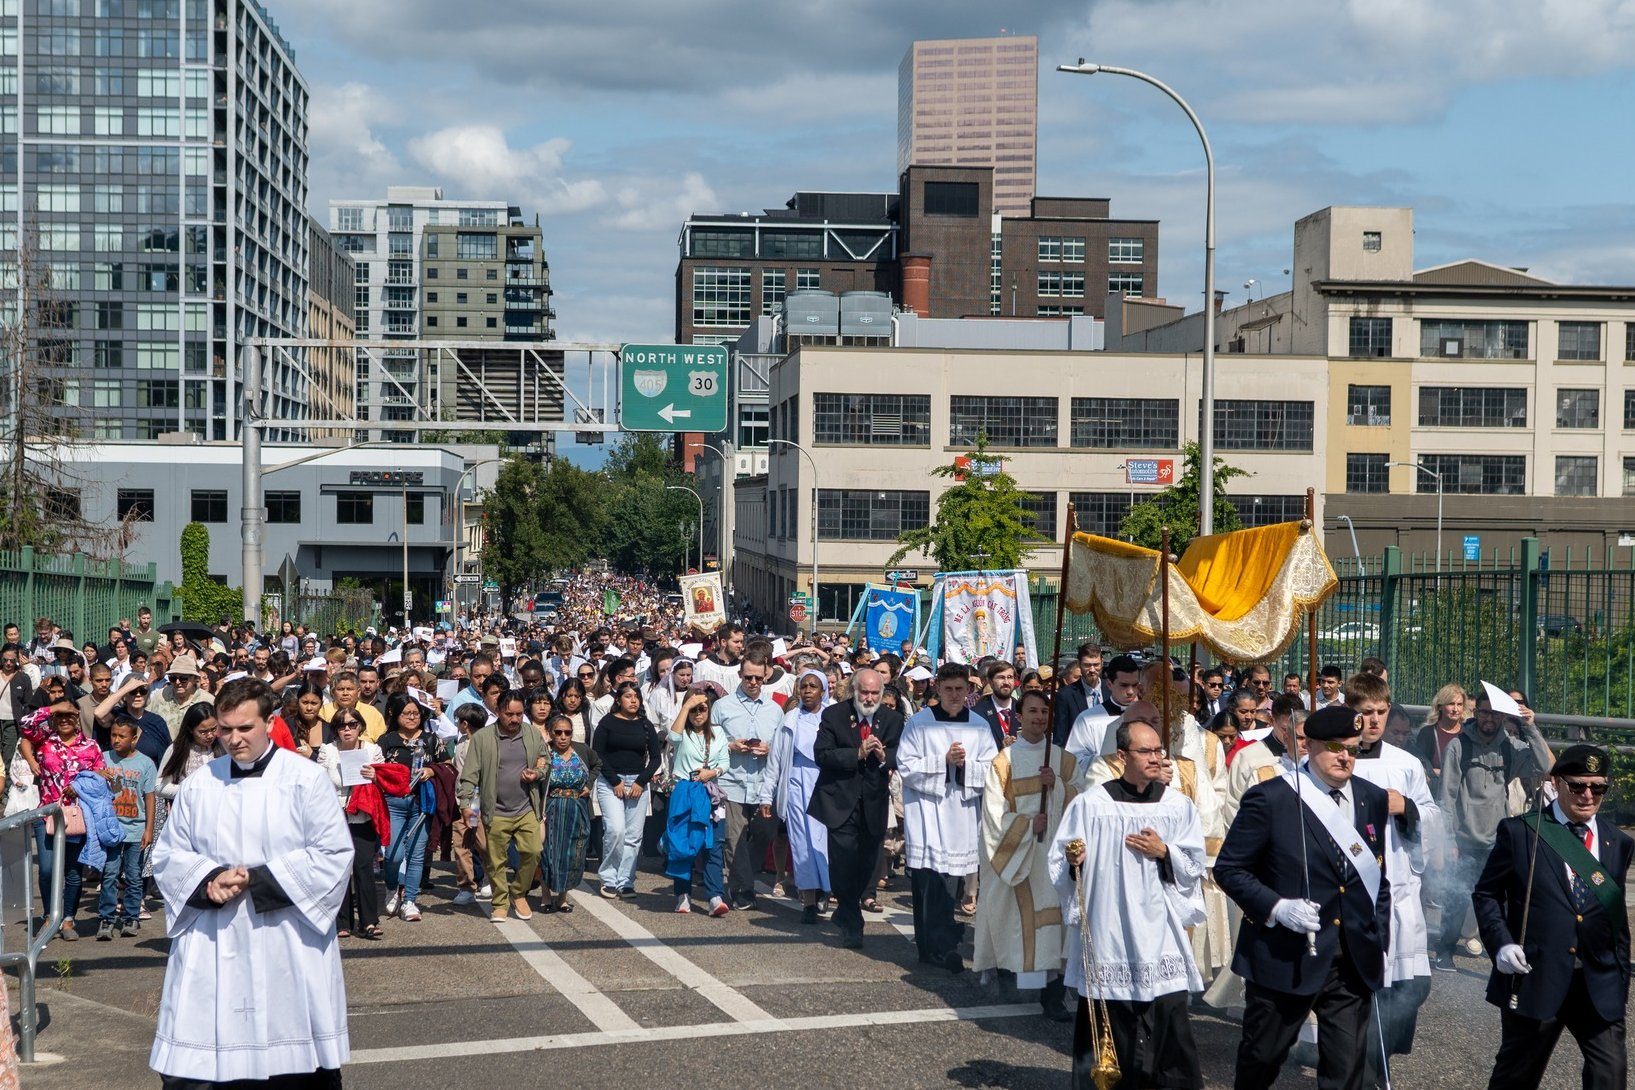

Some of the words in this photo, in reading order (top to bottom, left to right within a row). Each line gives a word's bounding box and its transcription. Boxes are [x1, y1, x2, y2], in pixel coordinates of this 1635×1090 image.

[625, 352, 676, 364] NORTH
[684, 354, 724, 365] WEST
[639, 379, 662, 392] 405
[694, 378, 713, 390] 30
[1128, 461, 1158, 469] Steve's
